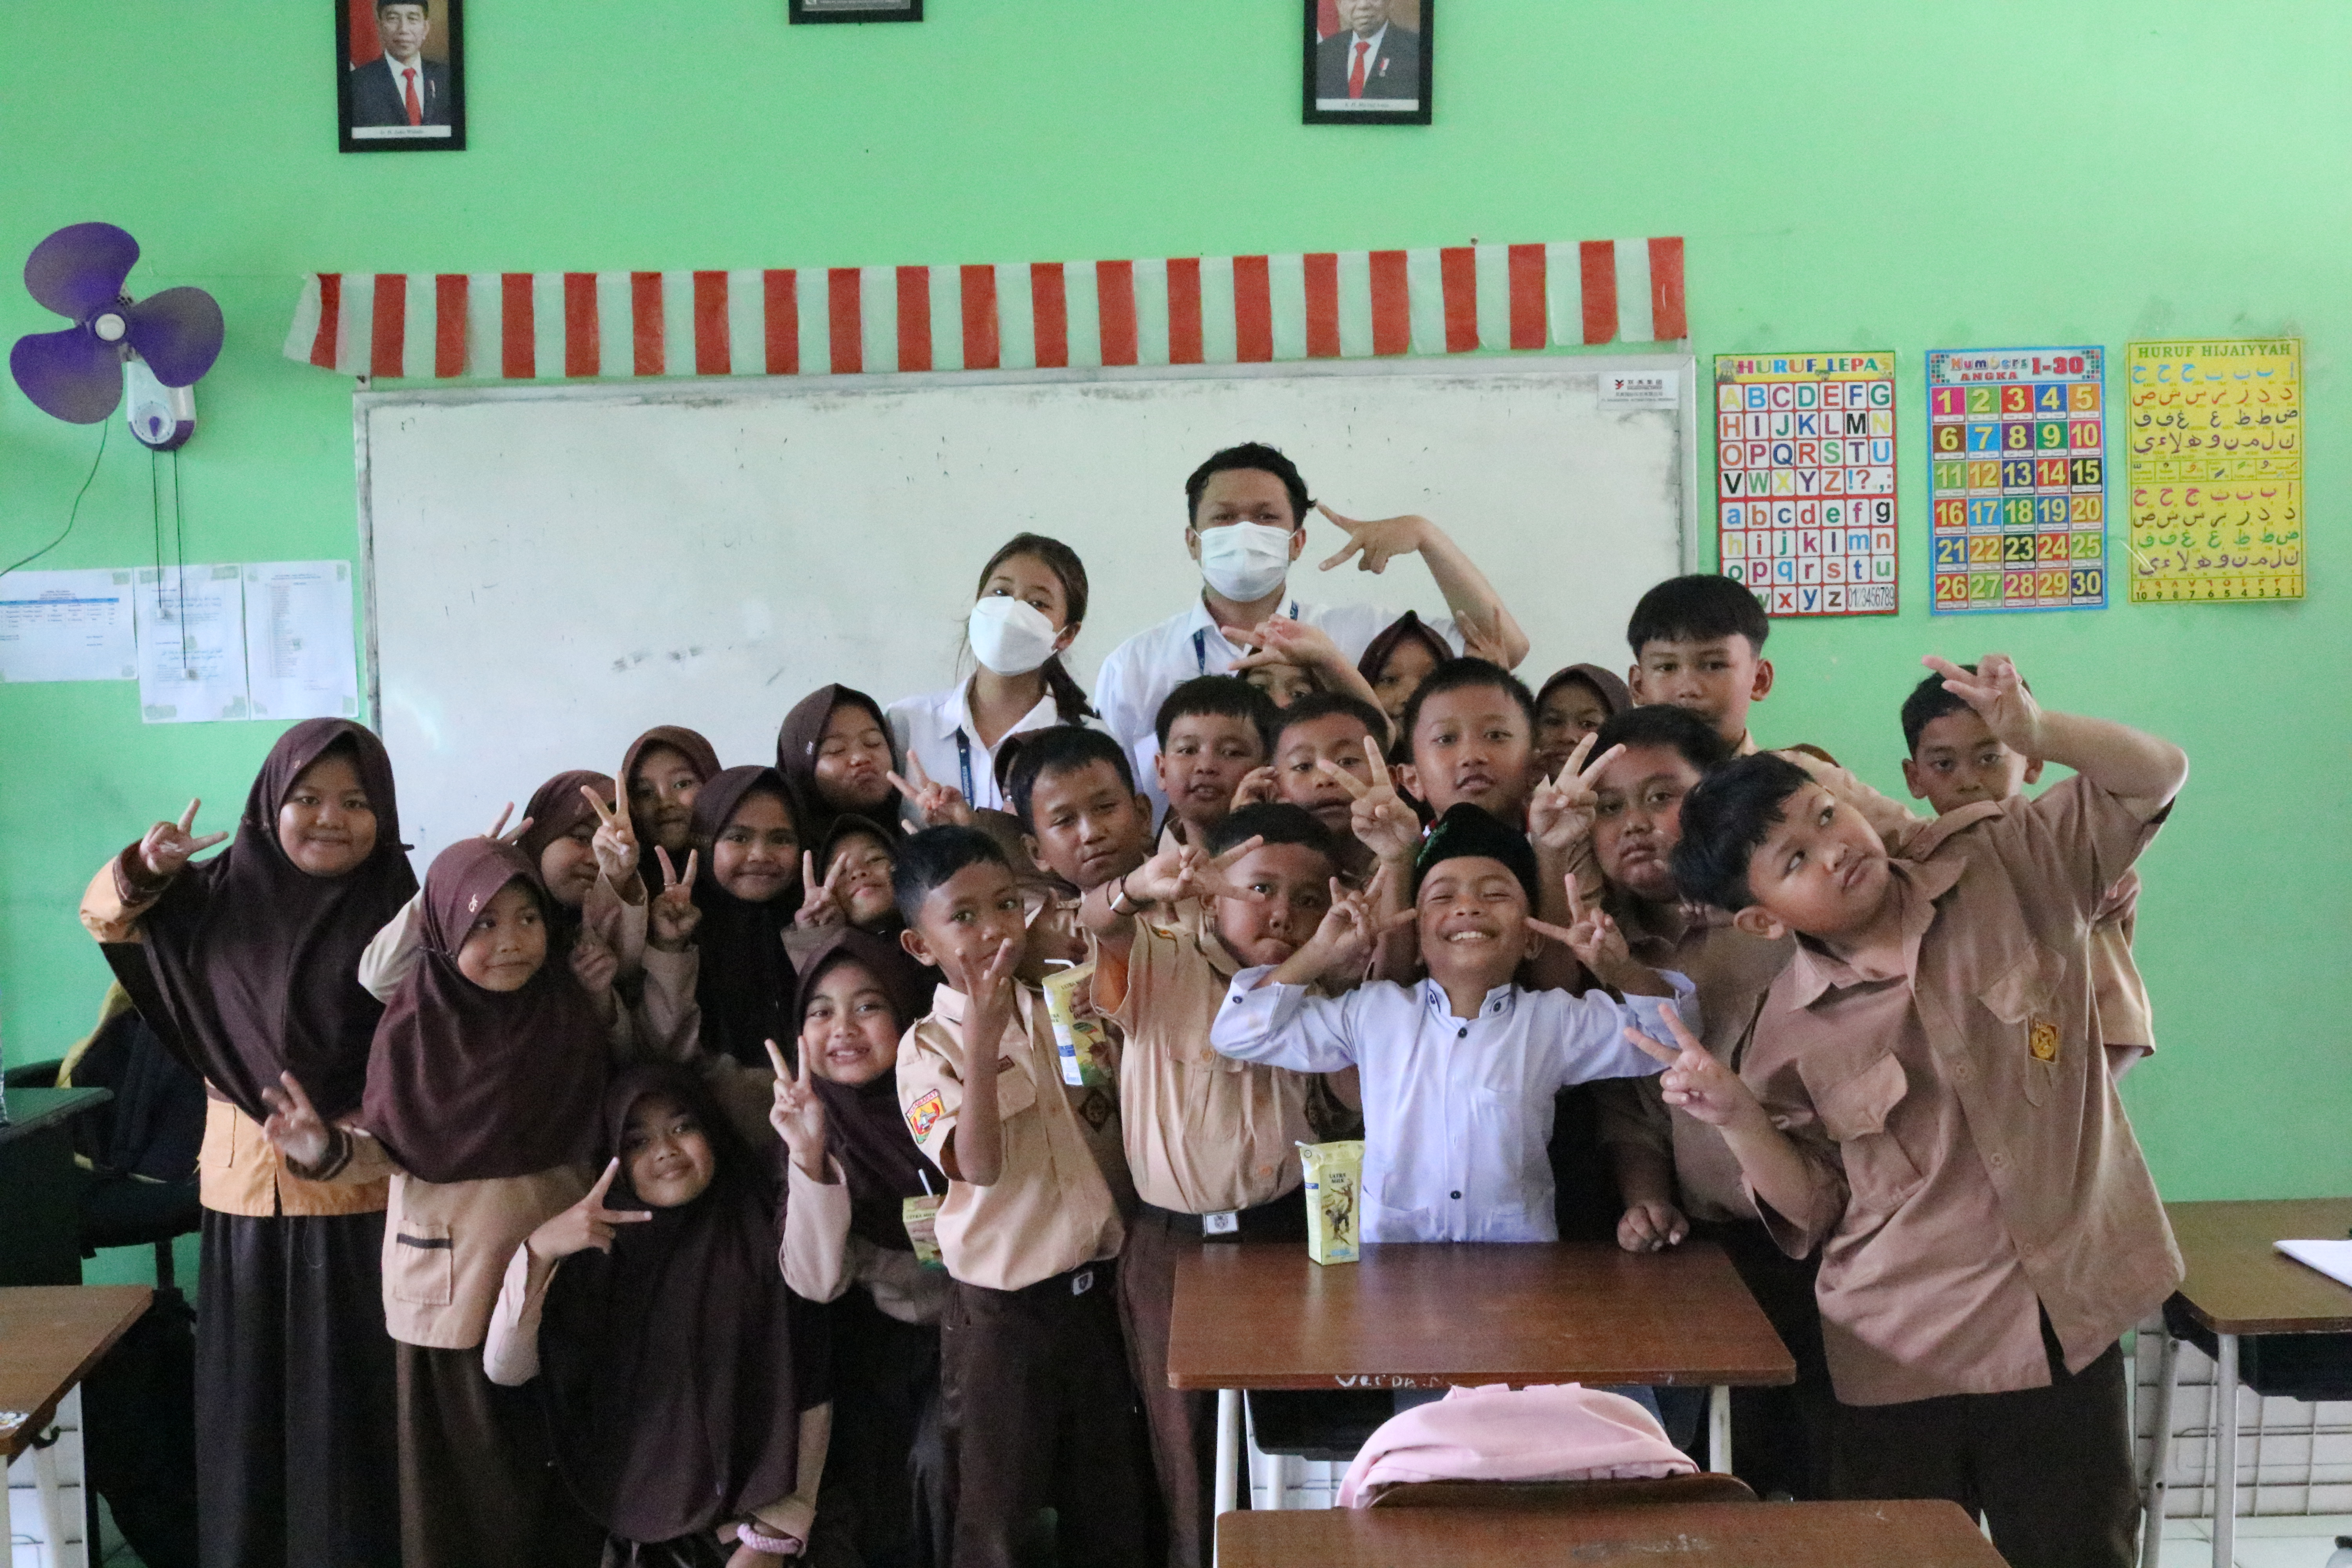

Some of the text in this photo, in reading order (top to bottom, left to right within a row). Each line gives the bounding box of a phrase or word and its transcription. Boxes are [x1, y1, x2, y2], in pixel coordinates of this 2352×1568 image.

[2139, 344, 2290, 358] HURUF HIJAIYYAH
[1738, 358, 1893, 374] HURUF LEPAS
[1951, 356, 2085, 375] Numbers 1-30
[1960, 371, 2018, 381] ANGKA
[1722, 385, 1889, 409] A B C D E F G
[1938, 386, 2092, 413] 1 2 3 4 5
[1723, 414, 1889, 437] H I J K L M N
[1940, 424, 2098, 450] 6 7 8 9 10
[1722, 441, 1889, 466] O P Q R S T U
[1724, 473, 1742, 494] V
[1748, 472, 1768, 493] W
[1775, 471, 1792, 492] X
[1798, 471, 1816, 492] Y
[1824, 470, 1841, 492] Z
[1936, 460, 2099, 488] 11 12 13 14 15
[1727, 501, 1890, 526] a b c d e f g
[1937, 497, 2100, 525] 16 17 18 19 20
[1728, 534, 1742, 555] h
[1757, 534, 1762, 554] i
[1779, 532, 1787, 554] j
[1804, 532, 1817, 553] k
[1849, 534, 1868, 550] m
[1877, 533, 1890, 549] n
[1938, 535, 2102, 563] 21 22 23 24 25
[1728, 560, 1890, 582] o p q r s t u
[1936, 570, 2102, 599] 26 27 28 29 30
[1779, 593, 1793, 608] x
[1803, 589, 1817, 609] y
[1828, 592, 1841, 607] z
[962, 765, 971, 798] INDONESIA
